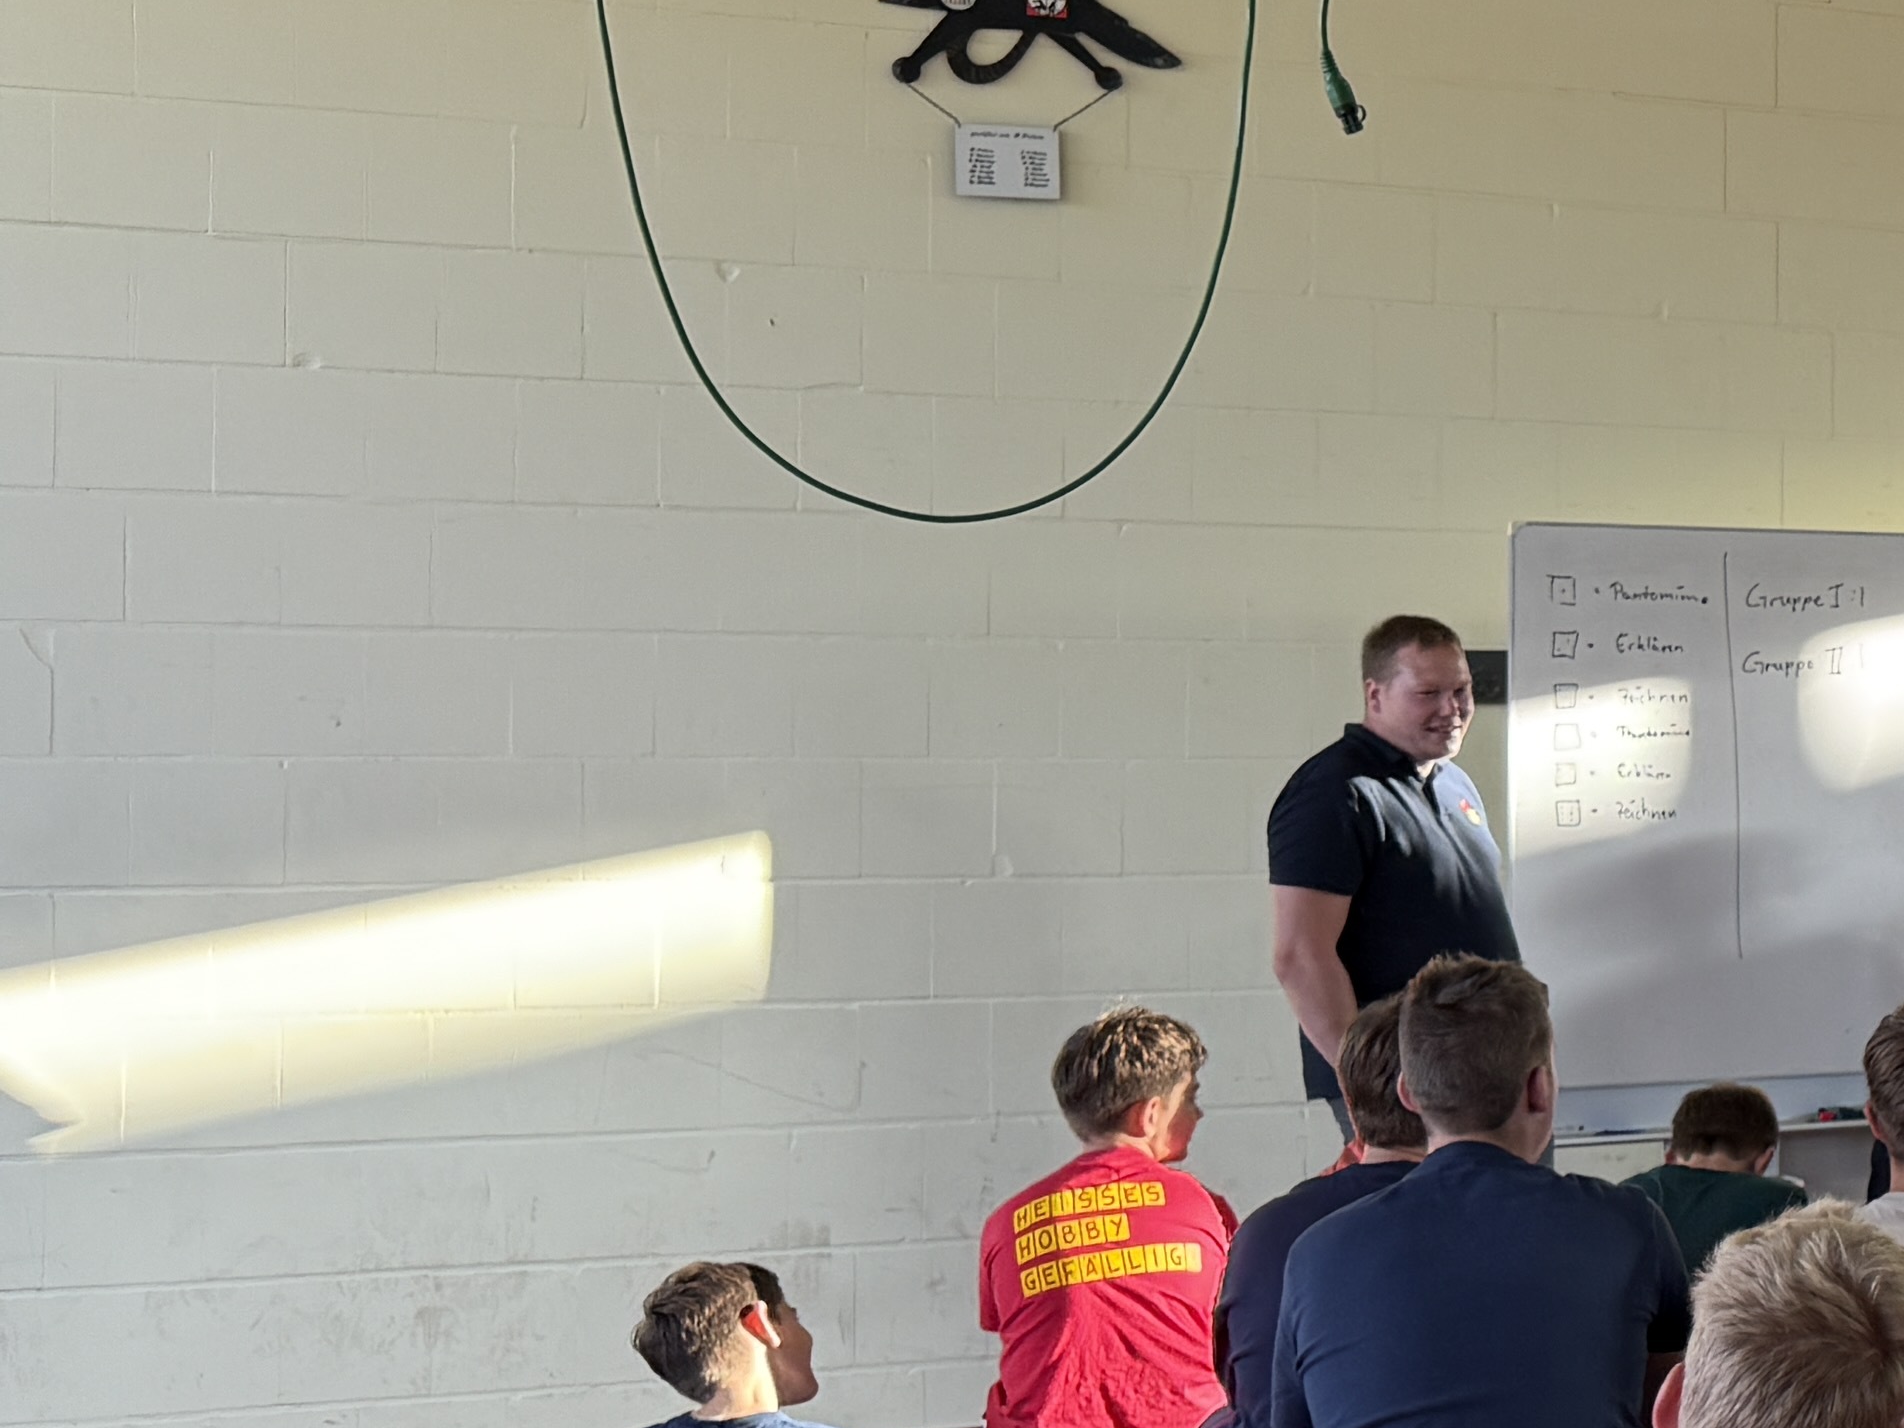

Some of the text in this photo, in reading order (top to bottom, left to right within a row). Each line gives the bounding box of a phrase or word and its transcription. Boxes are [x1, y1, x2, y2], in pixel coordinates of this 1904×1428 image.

[1745, 582, 1825, 613] Gruppe
[1742, 650, 1814, 679] Gruppe
[1014, 1183, 1164, 1231] HEISSES
[1018, 1215, 1125, 1259] HOBBY
[1023, 1243, 1201, 1296] GEFÄLLIG
